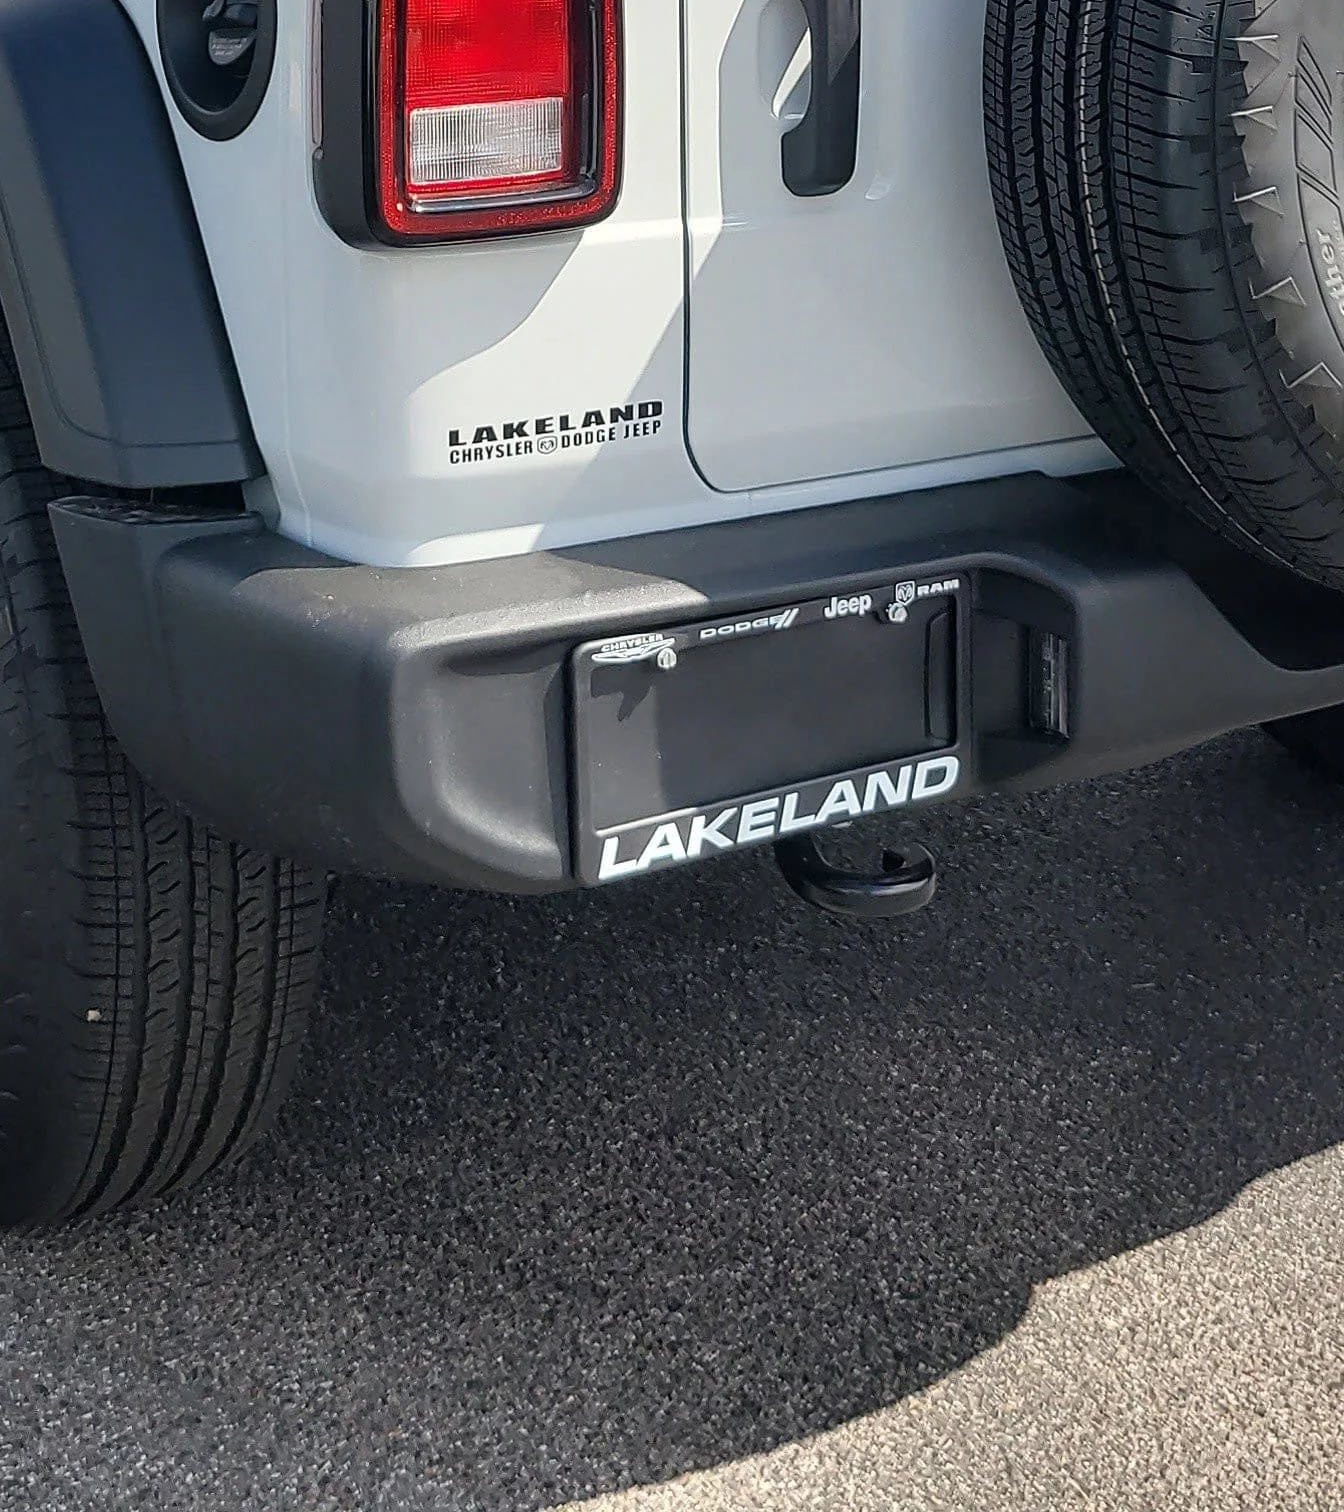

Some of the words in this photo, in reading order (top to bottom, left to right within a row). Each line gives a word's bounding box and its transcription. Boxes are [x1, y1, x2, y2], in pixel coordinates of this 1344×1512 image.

[448, 400, 664, 447] LAKELAND
[449, 441, 533, 464] CHRYSLER
[561, 426, 616, 449] DODGE
[623, 420, 662, 439] JEEP
[600, 633, 664, 652] CHRYSLER
[700, 614, 784, 640] DODGE
[823, 593, 872, 619] Jeep
[916, 579, 960, 600] RAM
[597, 755, 960, 881] LAKELAND
